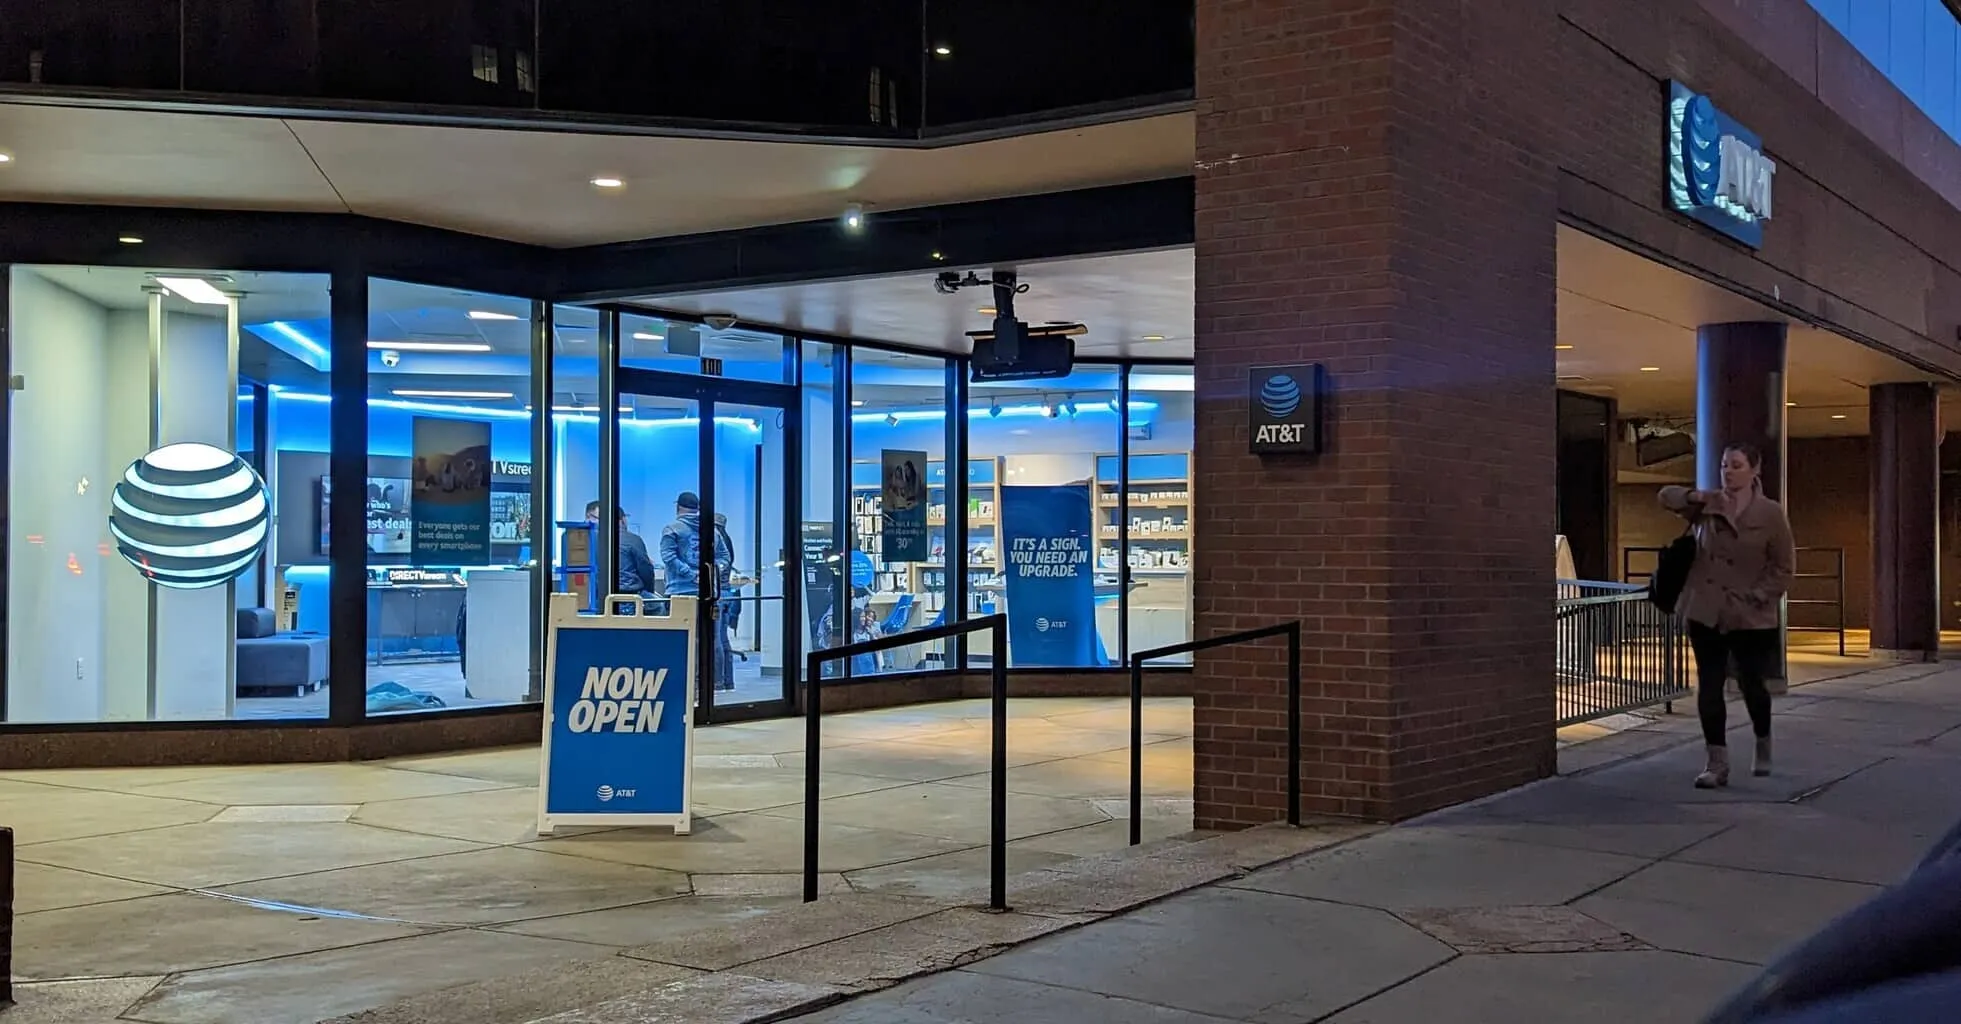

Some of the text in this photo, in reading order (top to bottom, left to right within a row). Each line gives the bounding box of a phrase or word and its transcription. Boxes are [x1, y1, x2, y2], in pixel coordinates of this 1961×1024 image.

[1256, 424, 1305, 443] AT&T
[419, 521, 451, 531] Everyone
[452, 524, 468, 532] gets
[418, 531, 434, 539] best
[418, 542, 438, 551] every
[1013, 538, 1081, 550] IT'S A SIGN.
[1010, 551, 1088, 564] YOU NEED AN
[1019, 565, 1078, 577] UPGRADE.
[1050, 621, 1067, 629] AT&T
[580, 666, 669, 700] NOW
[568, 700, 664, 734] OPEN
[616, 788, 636, 798] AT&T
